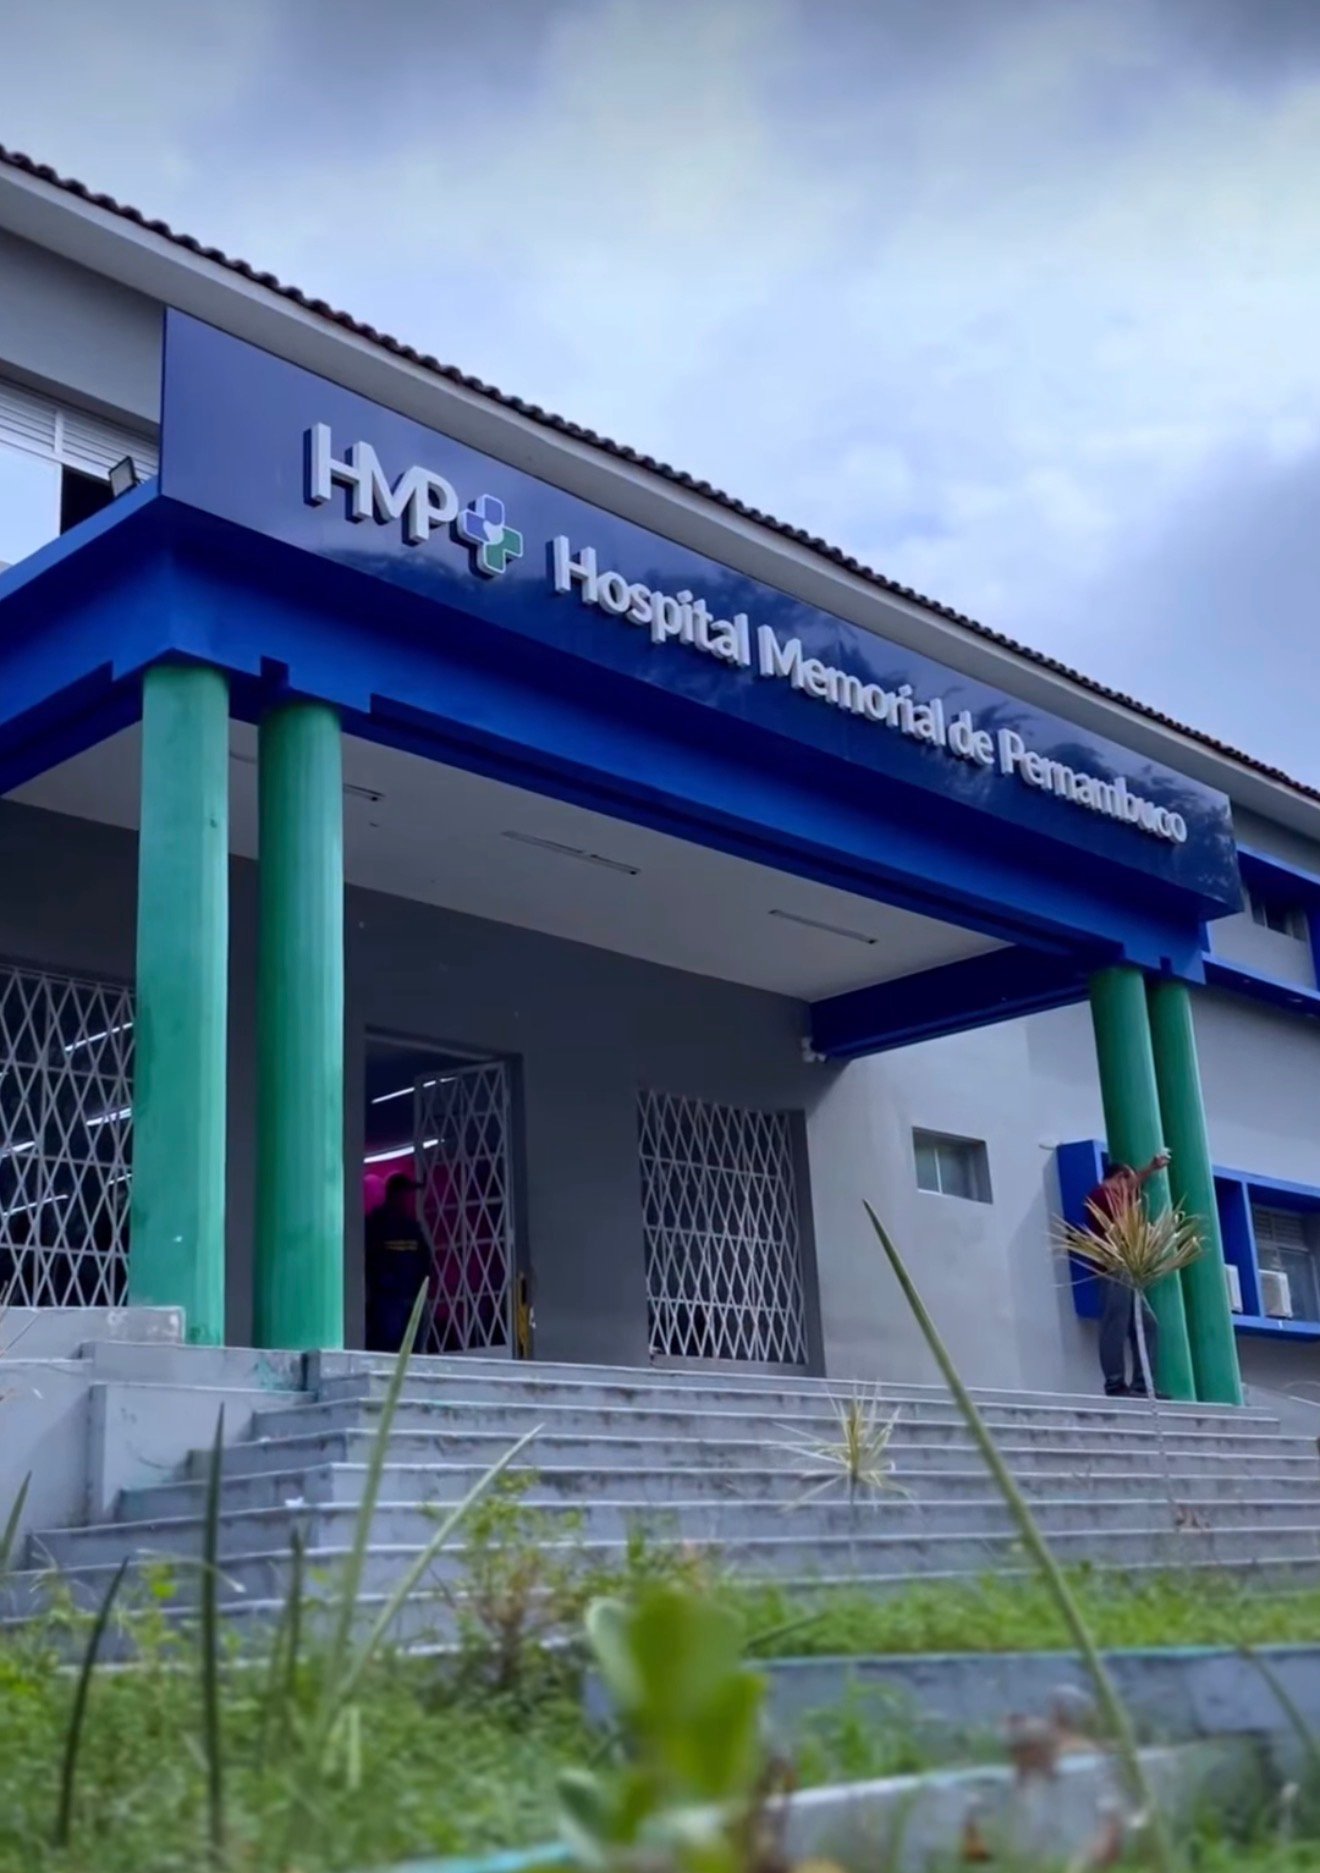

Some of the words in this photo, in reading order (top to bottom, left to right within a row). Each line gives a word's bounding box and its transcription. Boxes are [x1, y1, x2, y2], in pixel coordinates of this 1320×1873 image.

[307, 421, 460, 543] HMP
[552, 534, 750, 668] Hospital
[757, 624, 946, 746] Memorial
[948, 710, 996, 766] de
[999, 728, 1188, 844] Pernambuco
